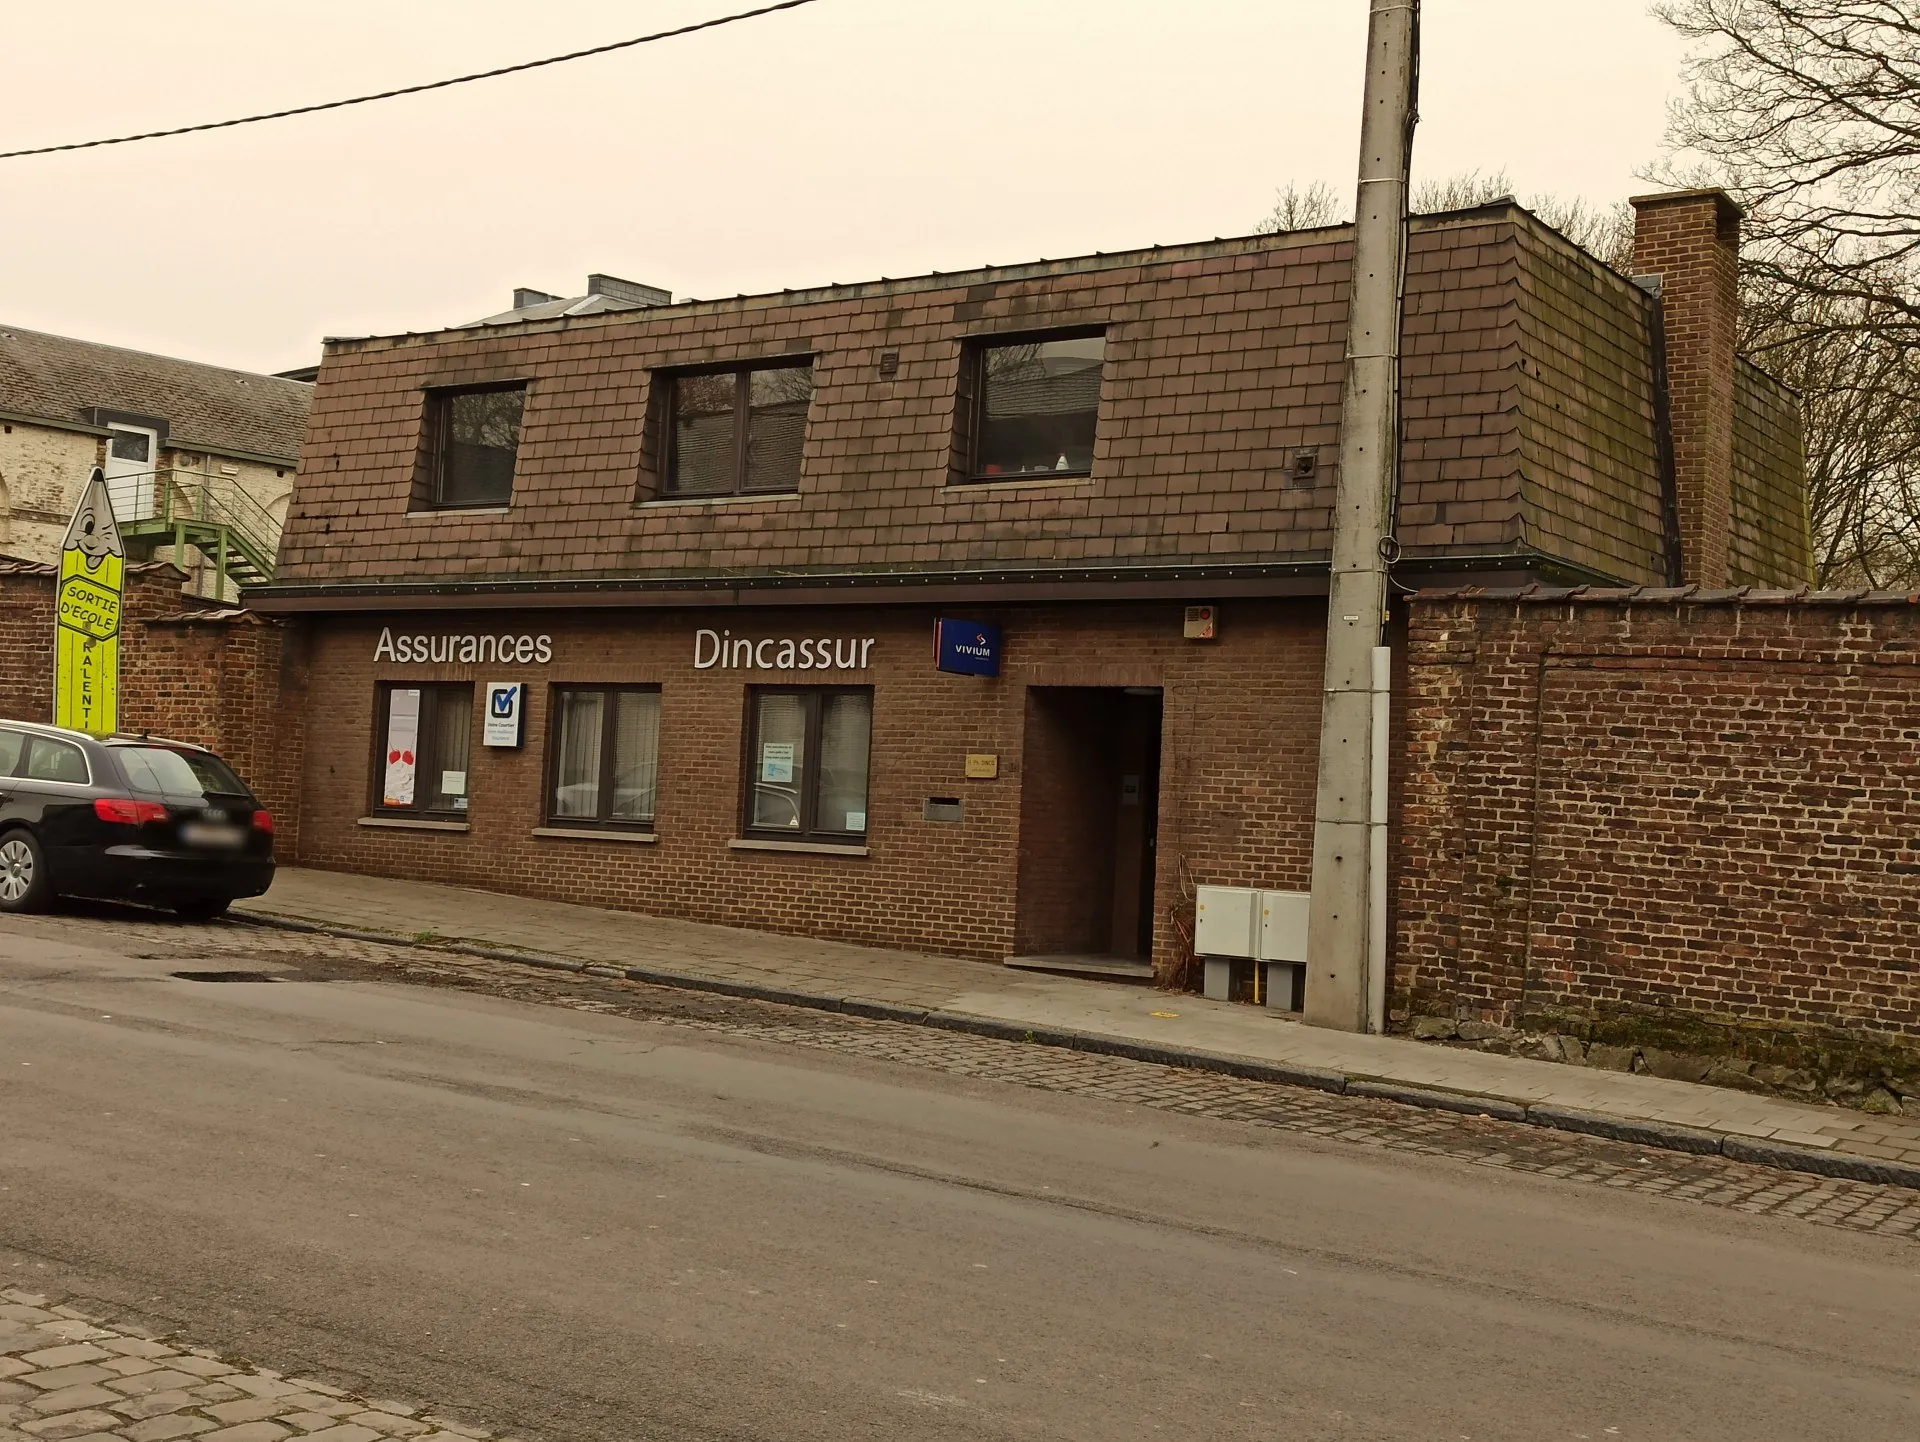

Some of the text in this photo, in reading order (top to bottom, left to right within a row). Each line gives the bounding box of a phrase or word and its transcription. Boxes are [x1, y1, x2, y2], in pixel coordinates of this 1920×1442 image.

[67, 586, 118, 614] SORTIE
[60, 601, 114, 630] D'ECOLE
[373, 626, 552, 663] Assurances
[694, 629, 875, 669] Dincassur
[955, 644, 991, 657] VIVIUM
